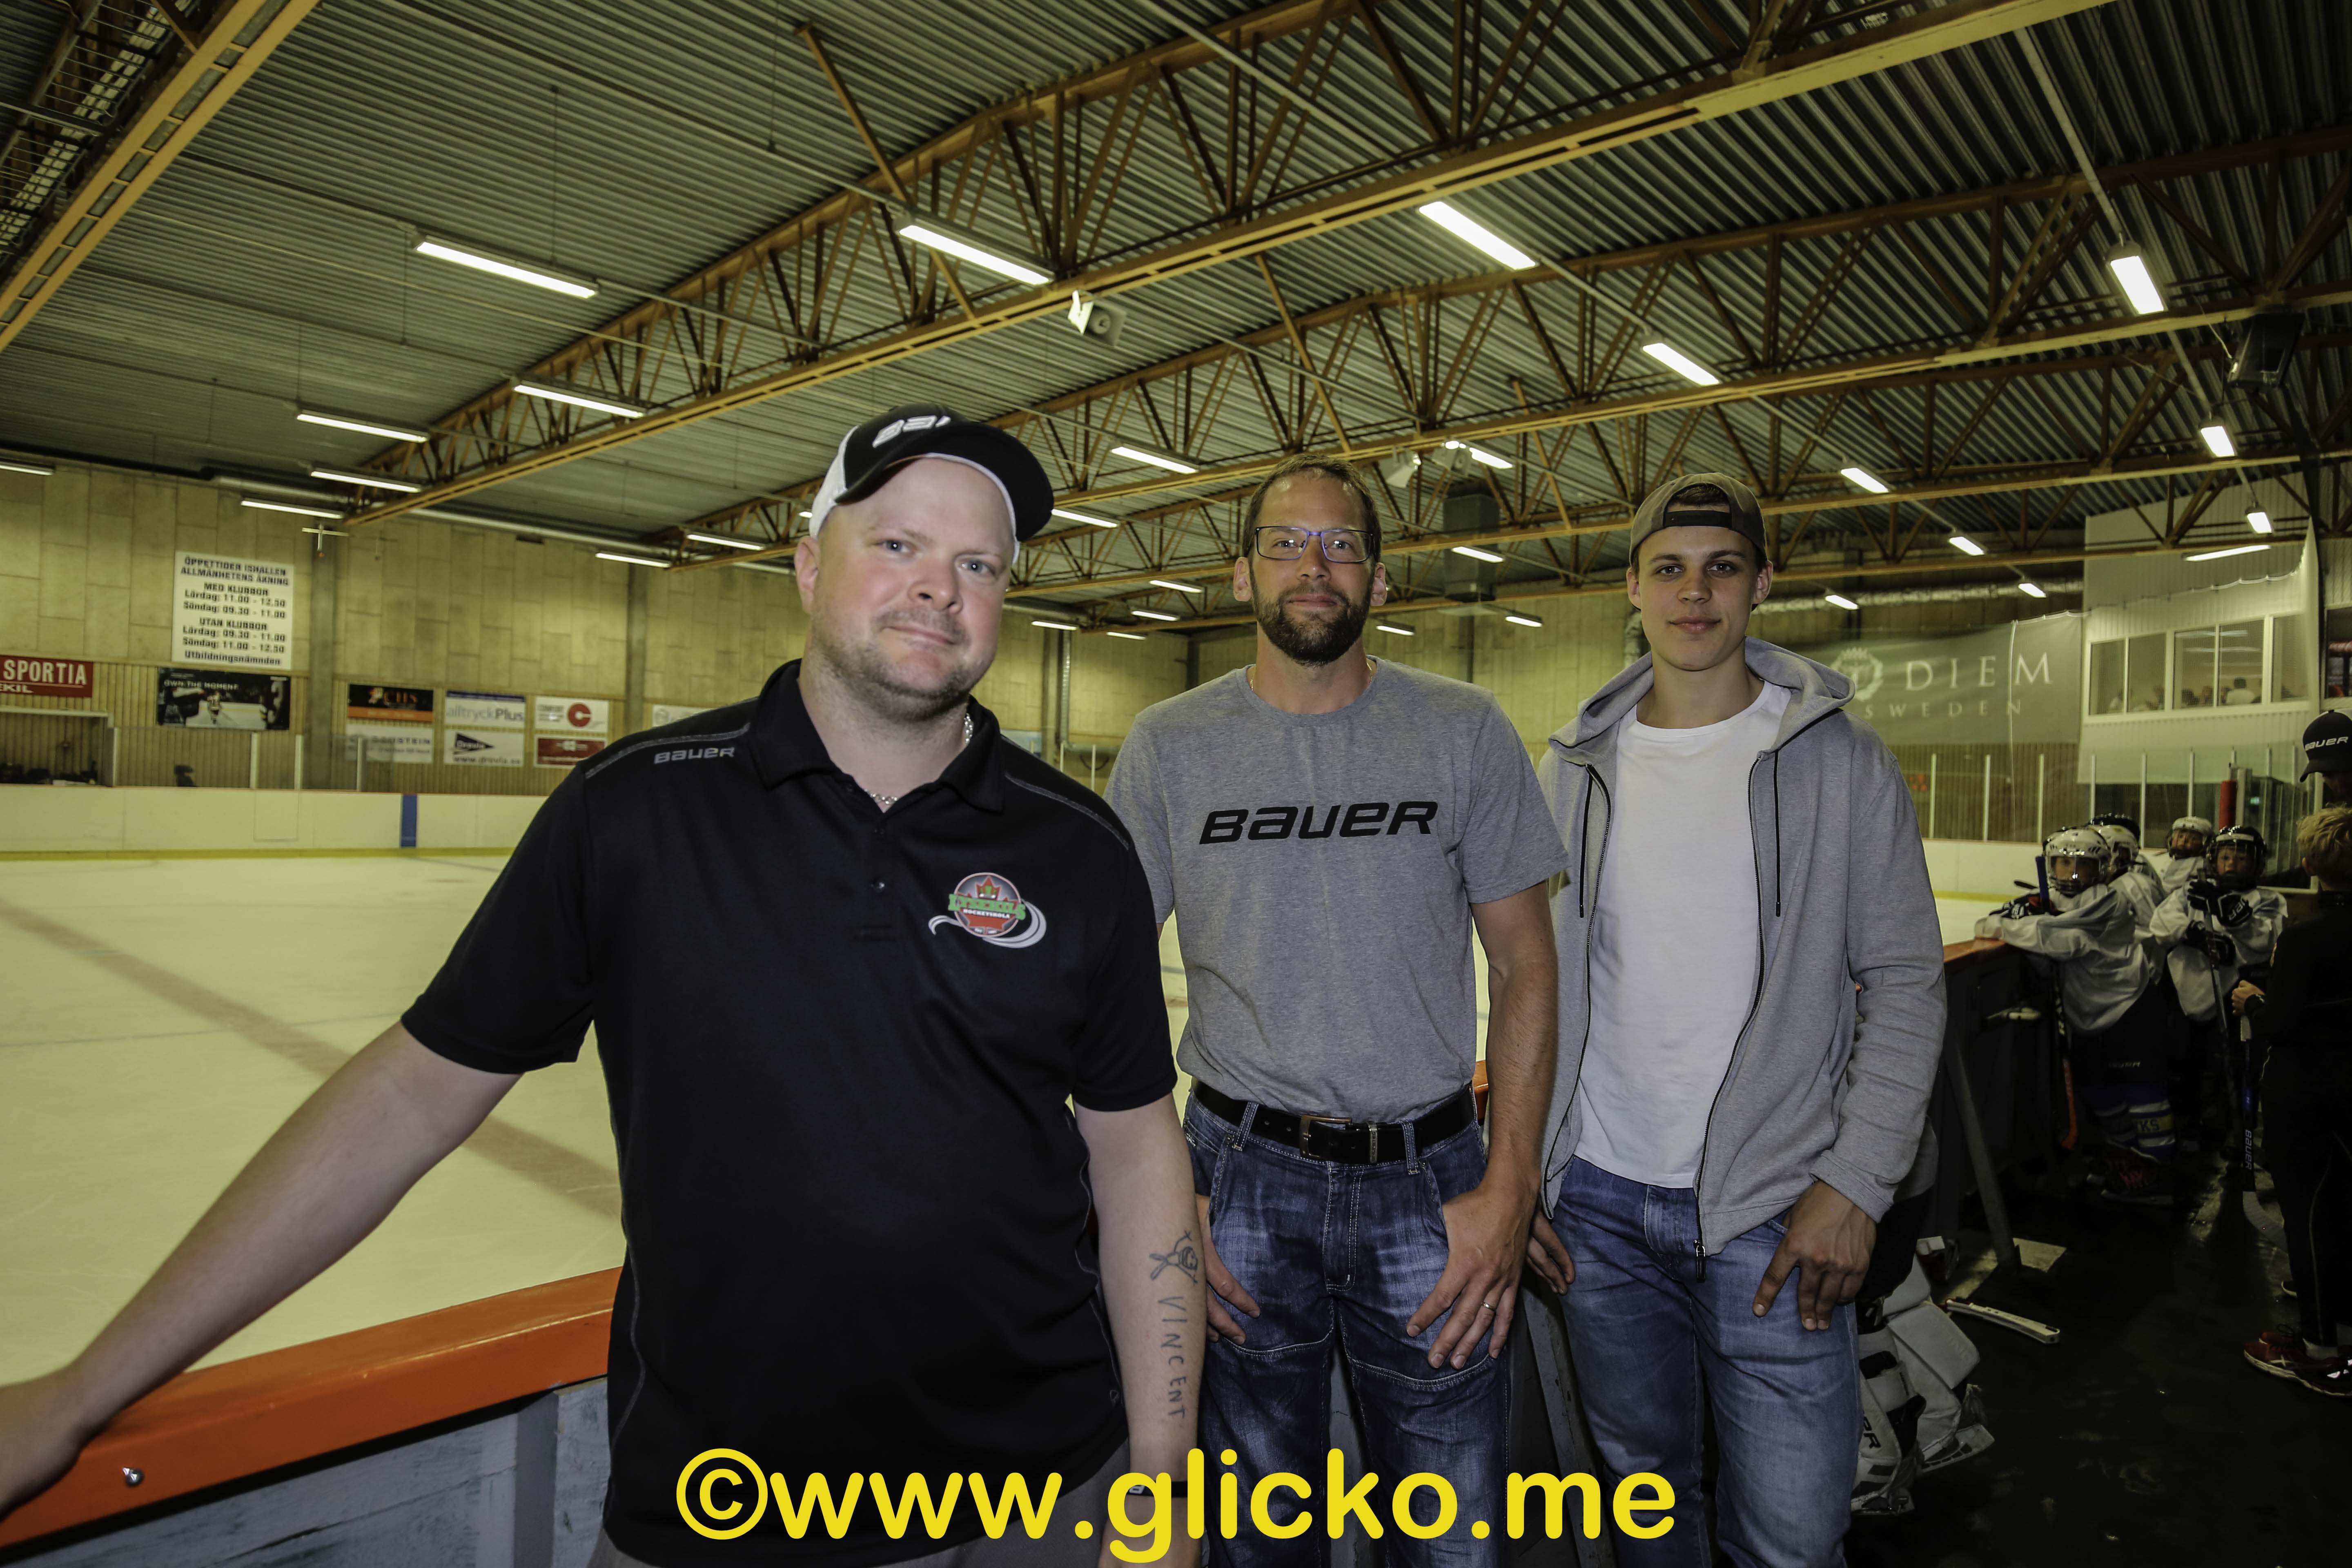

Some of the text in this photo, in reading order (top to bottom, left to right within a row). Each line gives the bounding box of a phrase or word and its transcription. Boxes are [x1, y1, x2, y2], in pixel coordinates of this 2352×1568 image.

[185, 556, 286, 575] ÖPPETTIDER ISHALLEN
[181, 566, 289, 586] ALLMÄNHETENS ÅKNING
[185, 589, 220, 601] Lördag:
[224, 594, 249, 603] 11.00
[204, 582, 268, 596] MED KLUBBOR
[183, 601, 220, 613] Söndag:
[261, 610, 285, 619] 11.00
[199, 617, 267, 630] UTAN KLUBBOR
[183, 626, 219, 637] Lördag:
[261, 633, 285, 642] 11.00
[183, 637, 219, 649] Söndag:
[223, 641, 248, 650] 11.00
[3, 659, 87, 685] SPORTIA
[1906, 653, 2053, 690] DIEM
[1865, 698, 2021, 719] SWEDEN
[1199, 801, 1438, 844] BAUER
[1158, 1296, 1188, 1419] VINCENT
